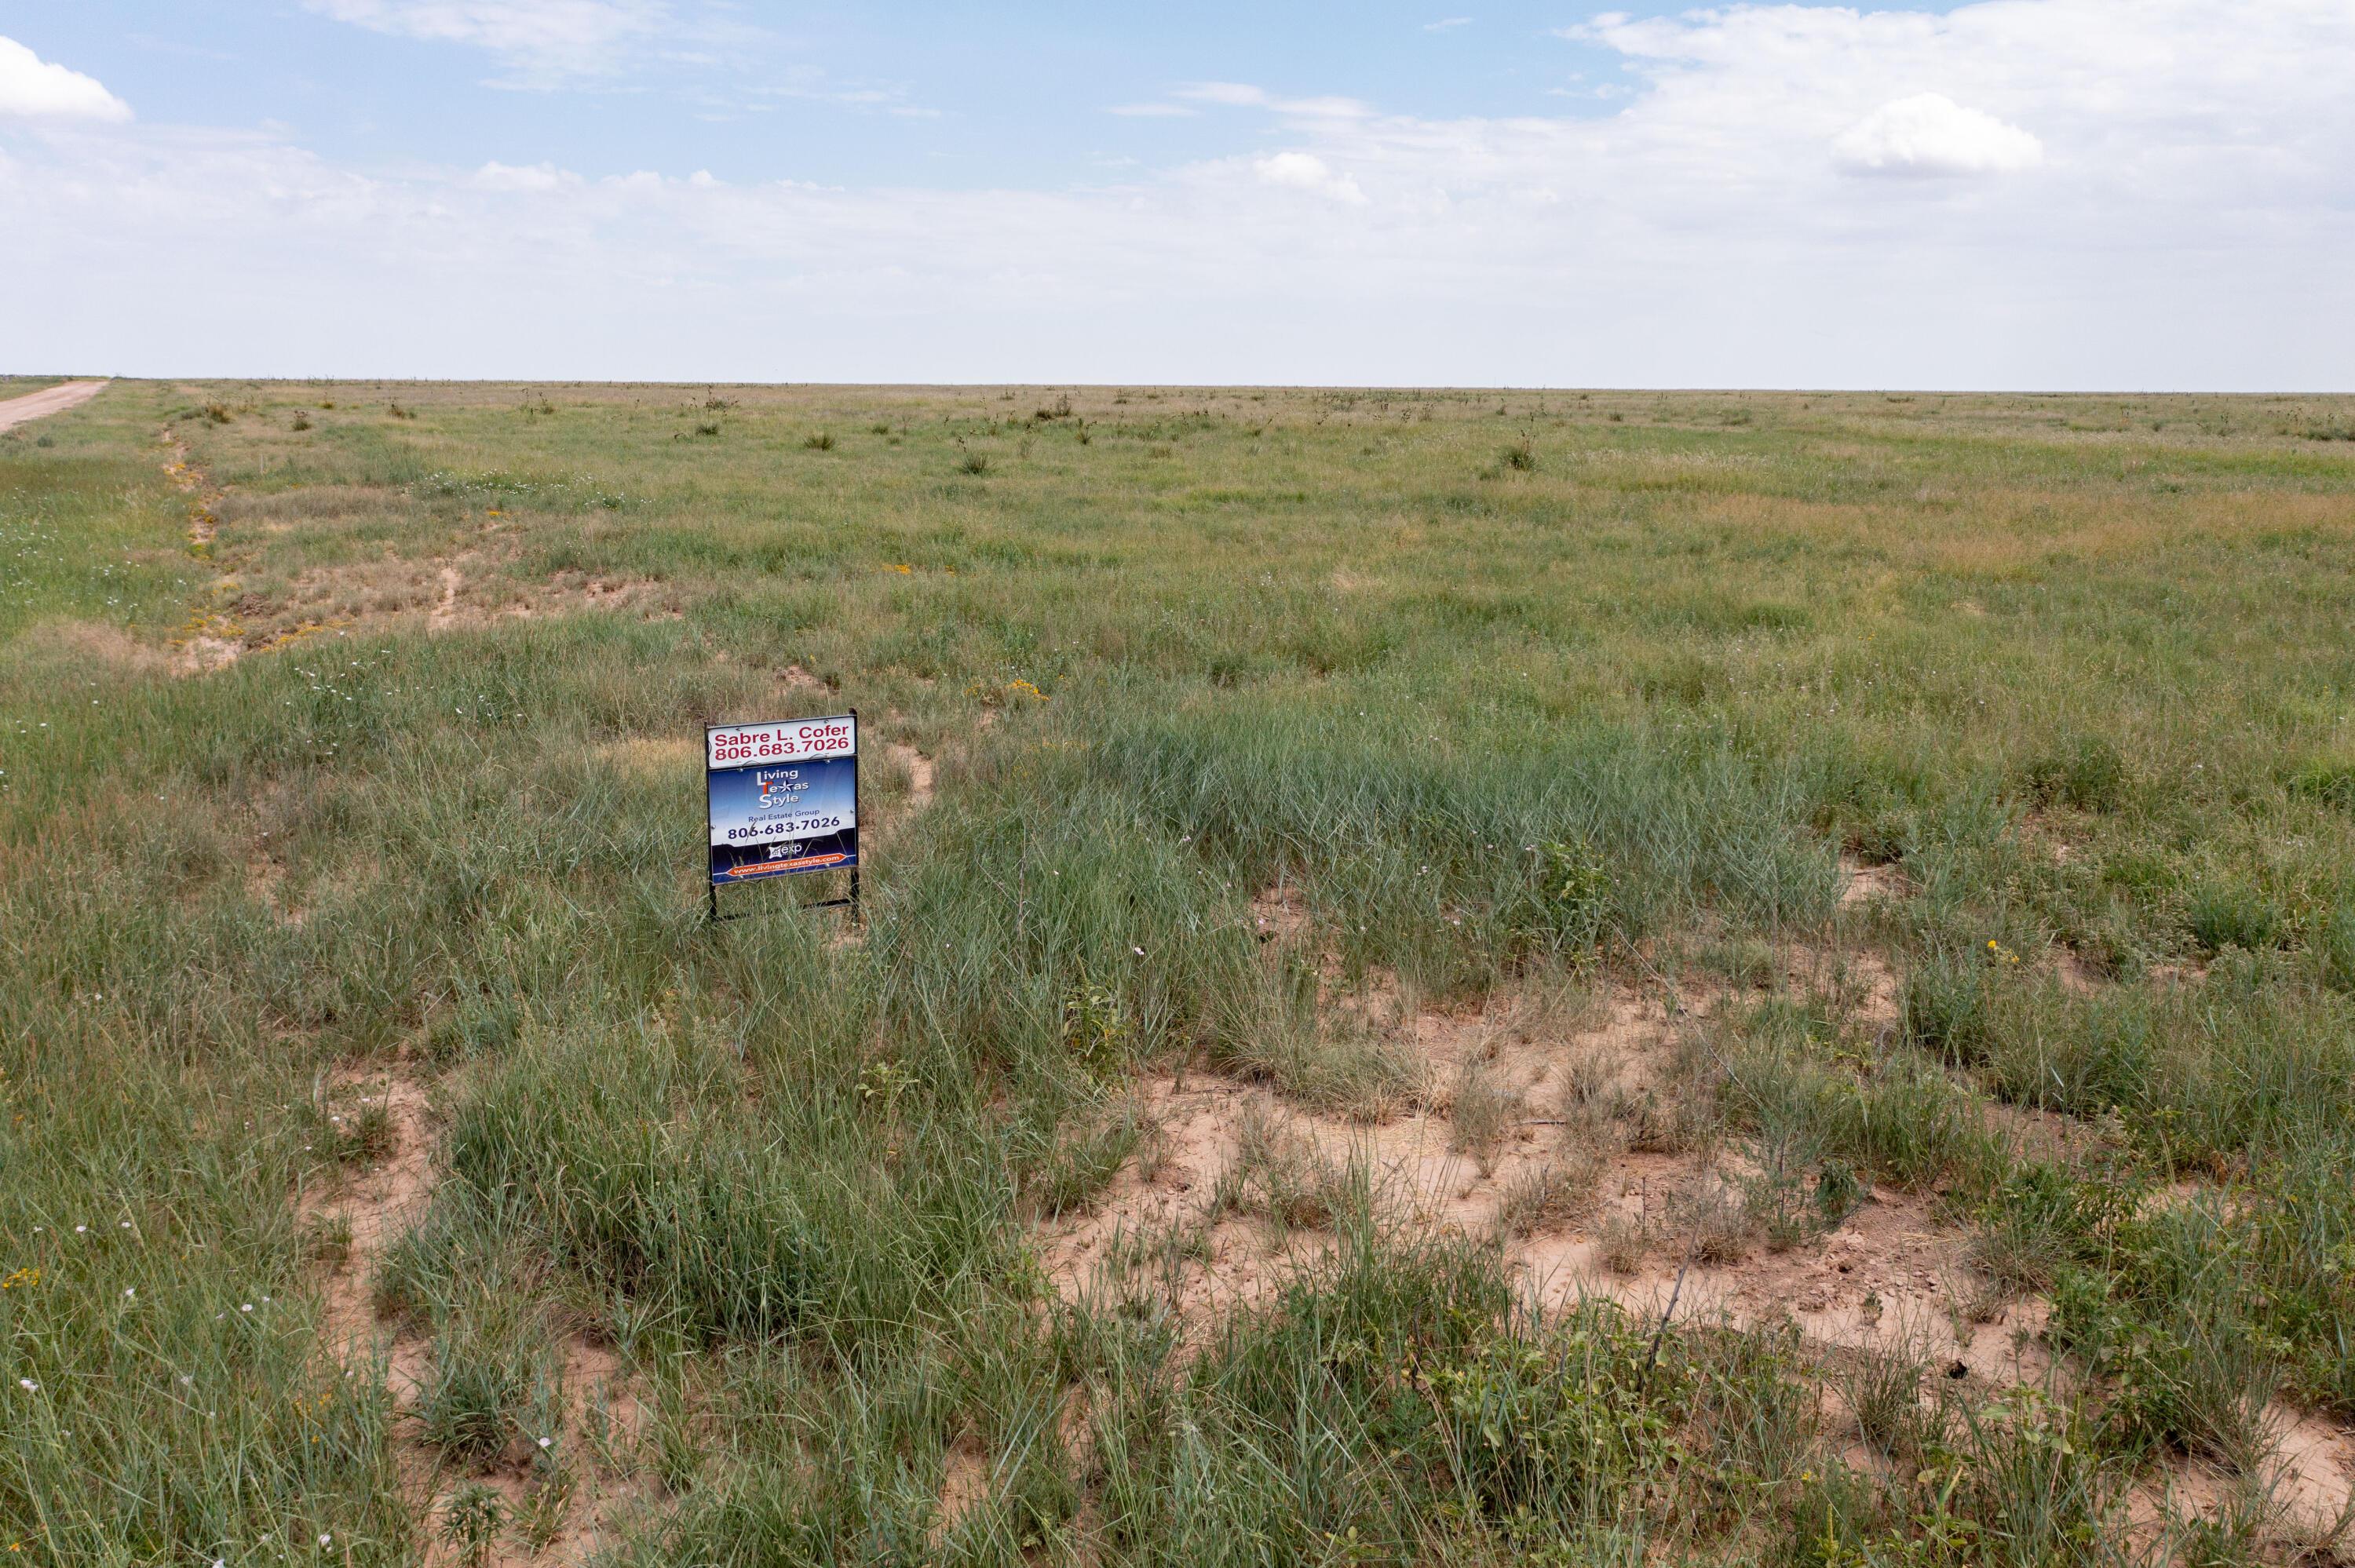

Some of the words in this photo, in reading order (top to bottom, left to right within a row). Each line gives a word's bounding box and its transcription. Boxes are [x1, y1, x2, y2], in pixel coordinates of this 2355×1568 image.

[714, 733, 770, 746] Sabre
[777, 730, 793, 741] L.
[799, 725, 849, 738] Cofer
[714, 737, 849, 760] 806.683.7026
[757, 770, 798, 786] Living
[759, 793, 799, 809] Style
